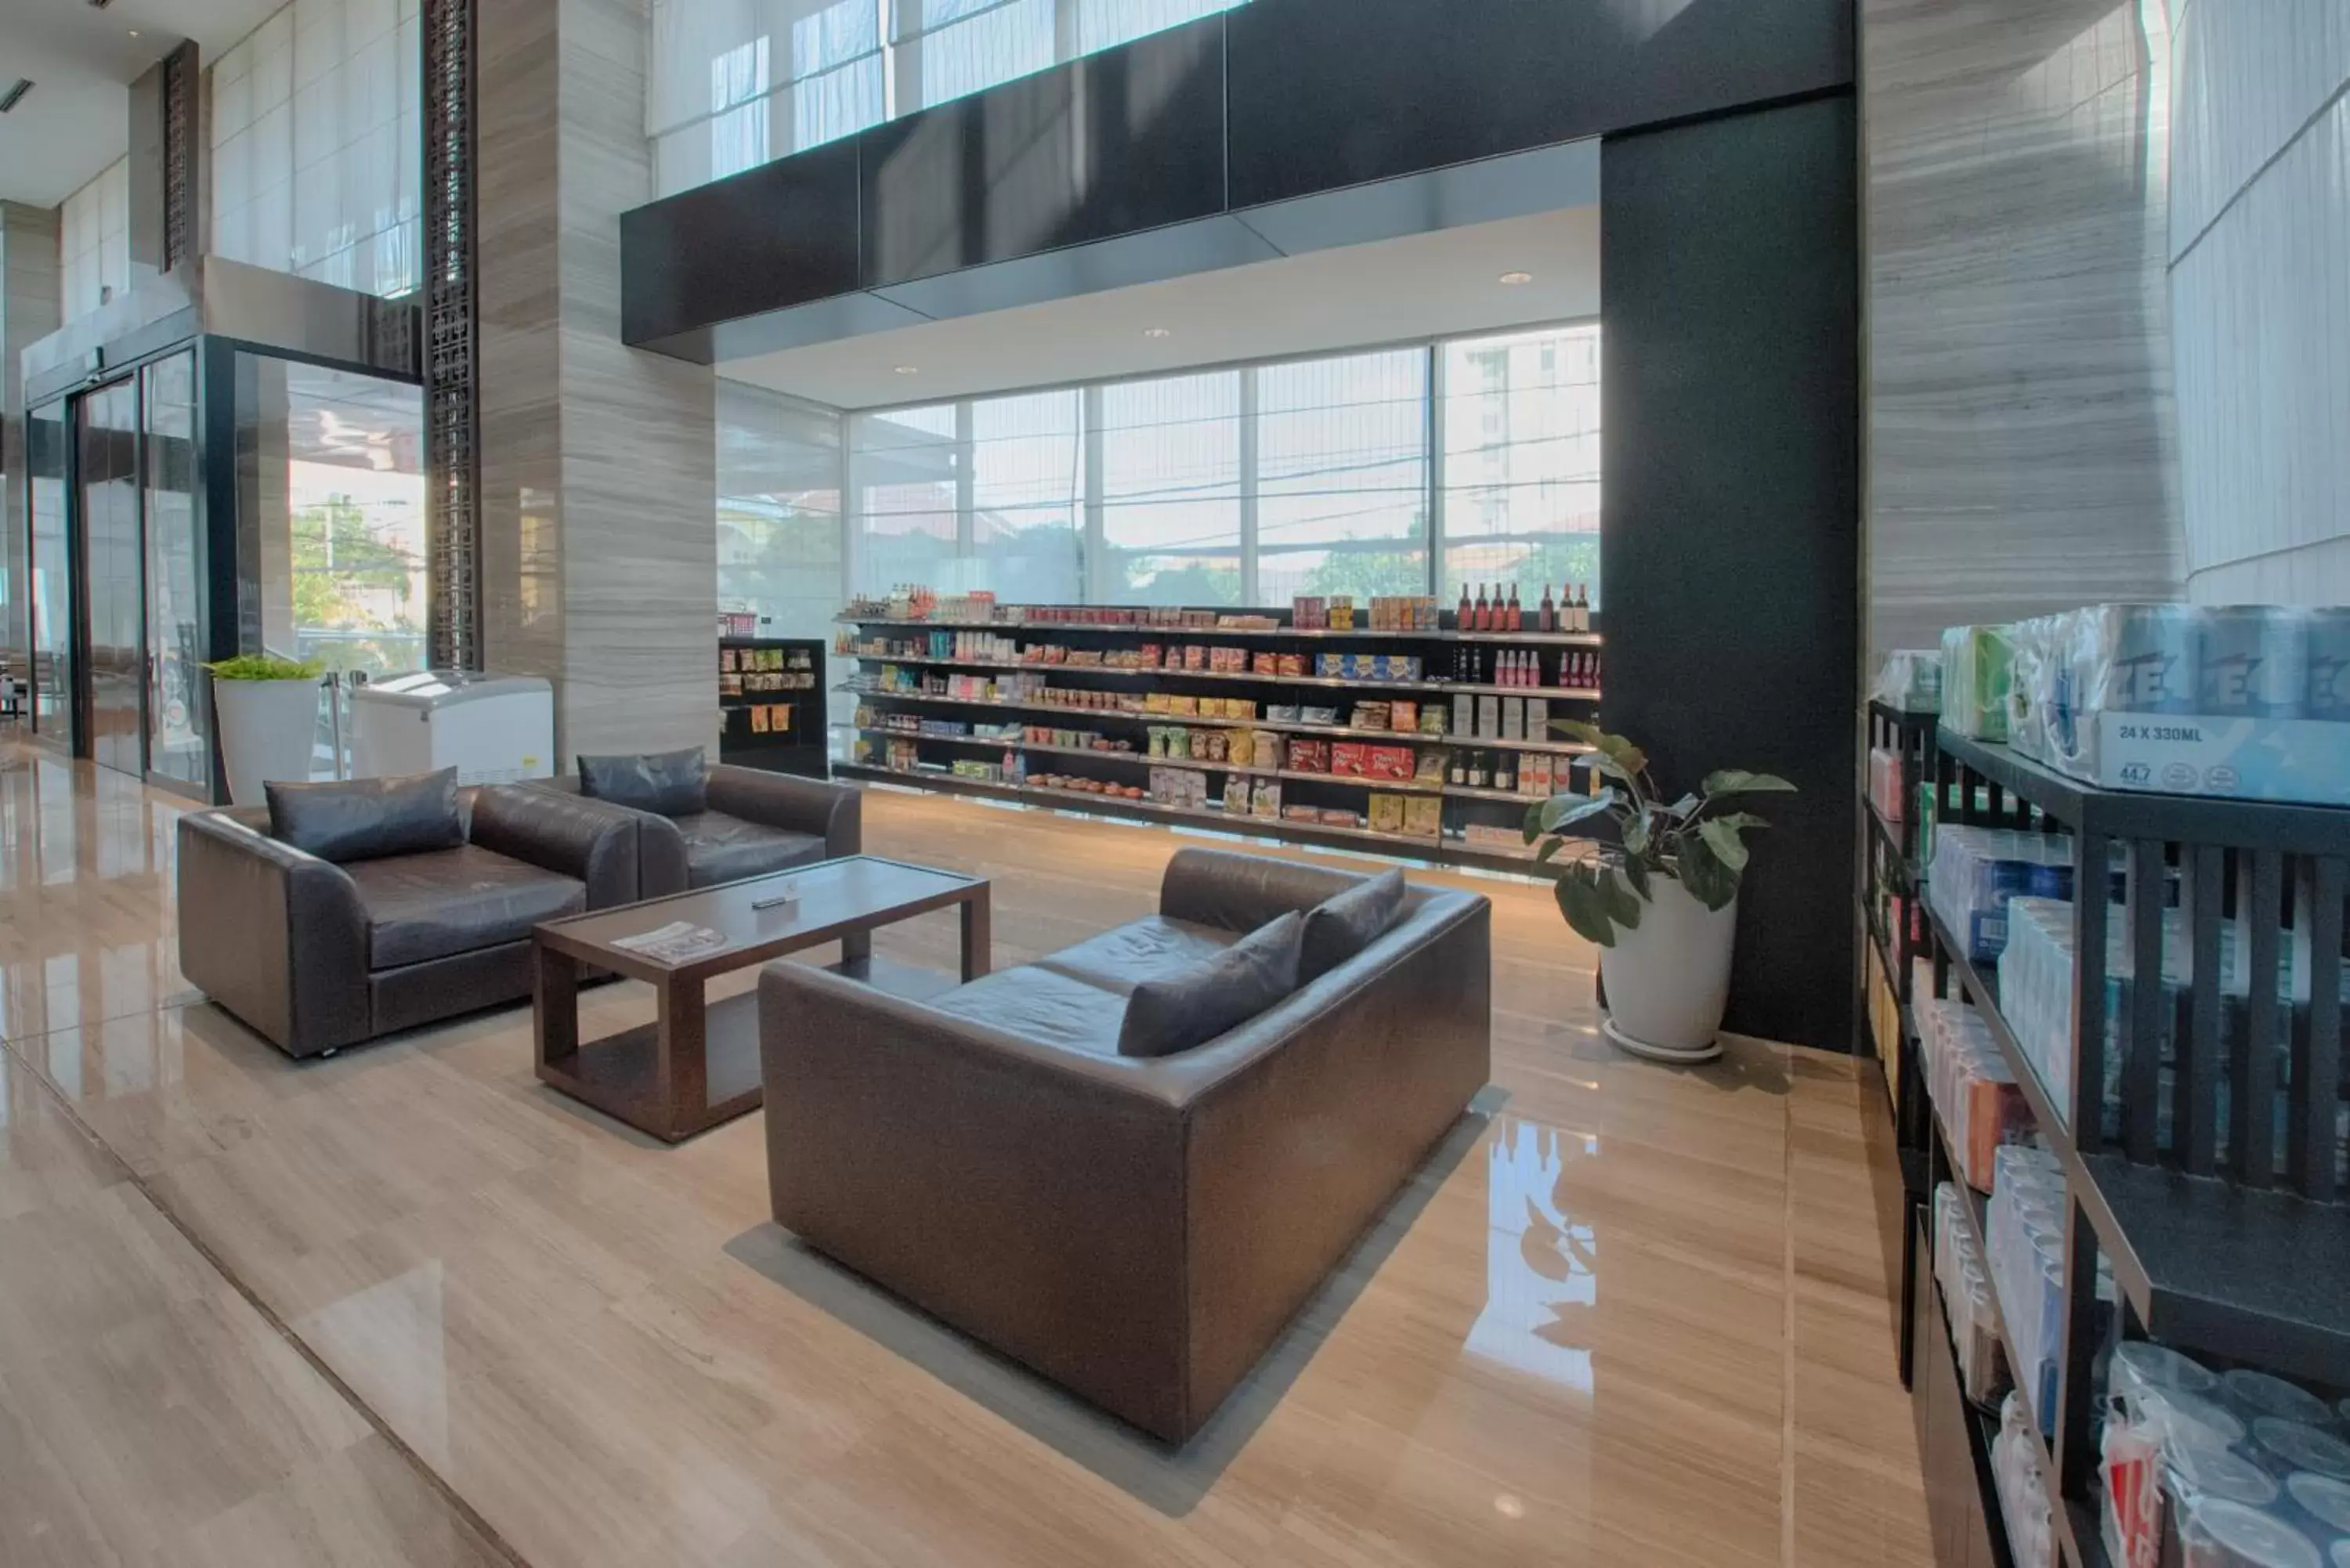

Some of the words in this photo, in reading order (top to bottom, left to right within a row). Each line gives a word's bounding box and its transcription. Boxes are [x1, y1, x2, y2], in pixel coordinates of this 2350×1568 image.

[2119, 725, 2135, 739] 24
[2141, 726, 2150, 740] X
[2153, 726, 2204, 742] 330ML
[2120, 767, 2151, 782] 44.7
